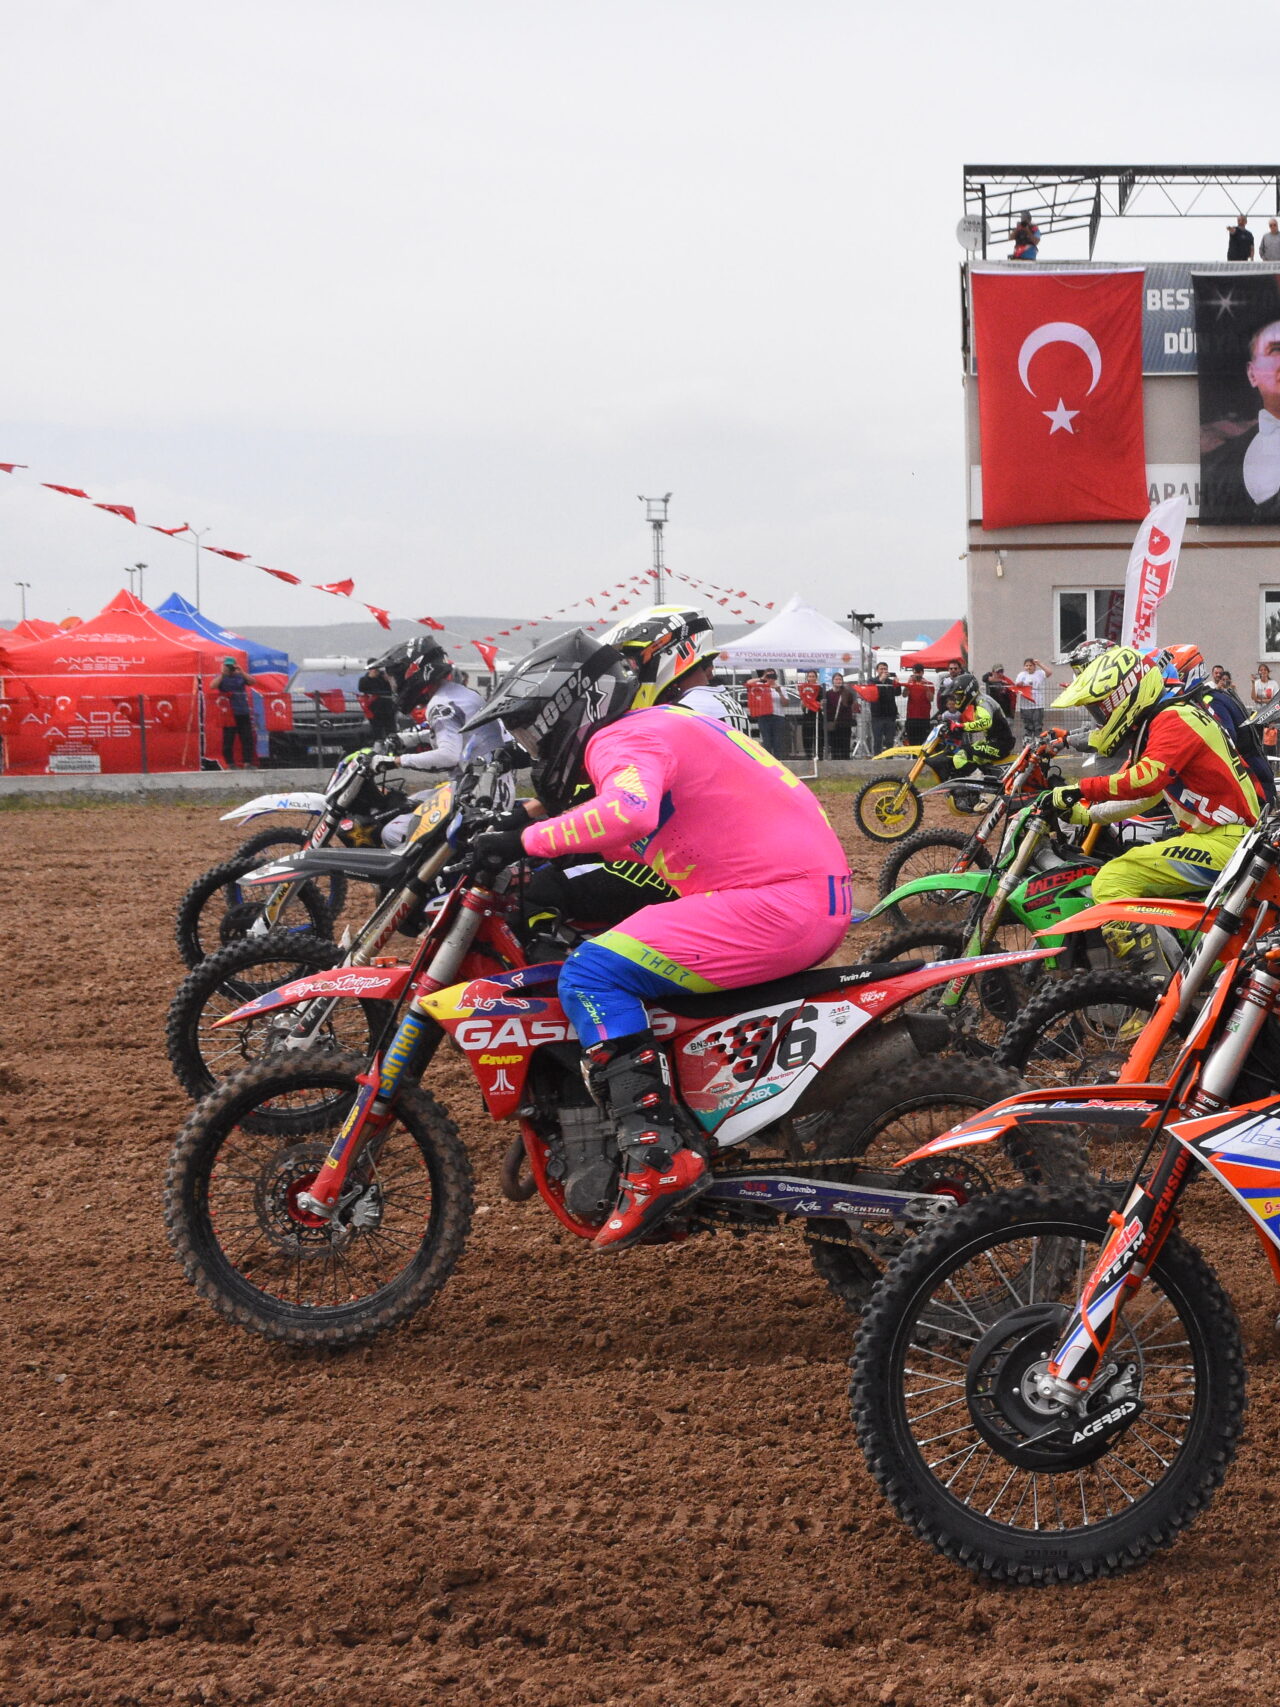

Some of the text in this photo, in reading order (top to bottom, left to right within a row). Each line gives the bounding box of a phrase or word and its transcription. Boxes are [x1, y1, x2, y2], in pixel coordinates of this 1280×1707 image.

[1140, 564, 1163, 619] TMF
[54, 656, 145, 664] ANADOLU
[530, 668, 592, 739] 100%
[539, 800, 632, 851] THOR
[1161, 845, 1214, 867] THOR
[641, 947, 691, 983] THOR
[839, 971, 872, 983] Twin Air
[786, 1183, 817, 1195] brembo
[1101, 1231, 1147, 1285] TEAM
[1071, 1401, 1137, 1445] ACERBIS
